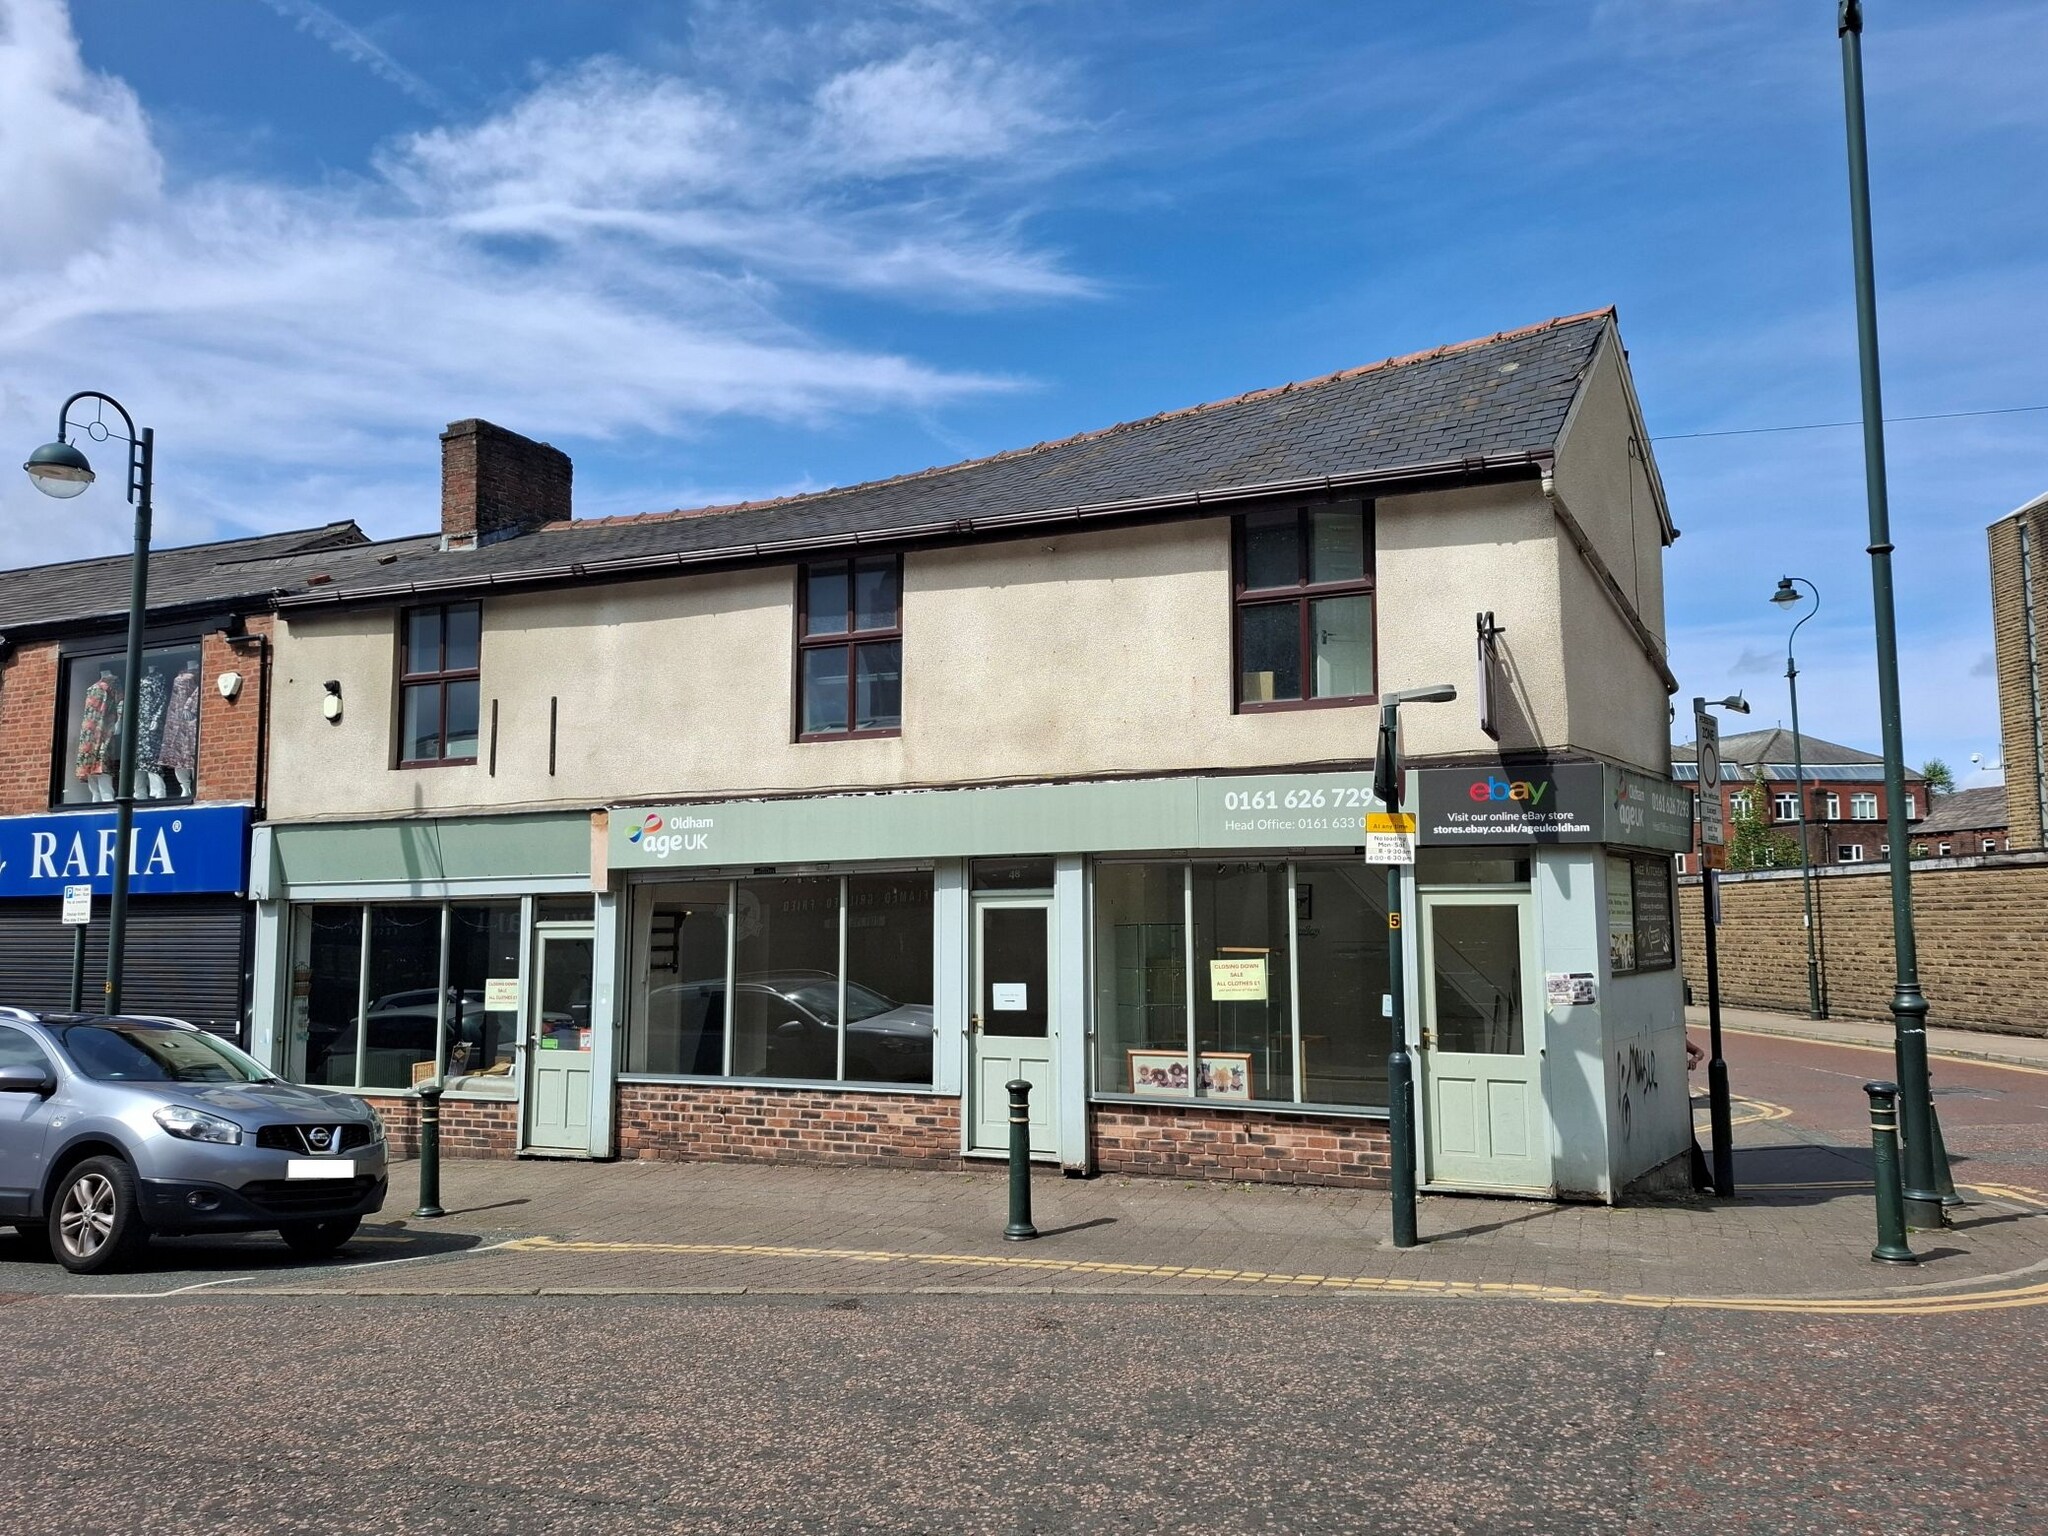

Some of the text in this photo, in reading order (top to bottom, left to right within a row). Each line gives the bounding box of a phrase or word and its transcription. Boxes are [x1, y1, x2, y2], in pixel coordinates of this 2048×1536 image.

[1701, 726, 1715, 741] ZONE
[1469, 776, 1548, 805] ebay
[1224, 790, 1278, 811] 0161
[1284, 789, 1326, 809] 626
[670, 815, 714, 830] Oldham
[1447, 812, 1469, 822] Visit
[1489, 812, 1519, 821] online
[1521, 811, 1546, 822] eBay
[1548, 811, 1574, 820] store
[1225, 819, 1254, 831] Head
[1257, 818, 1295, 830] Office:
[1298, 817, 1328, 829] 0161
[1332, 817, 1355, 828] 633
[1433, 823, 1590, 835] stores.ebay.co.uk/ageukoldham
[1390, 914, 1399, 926] 5
